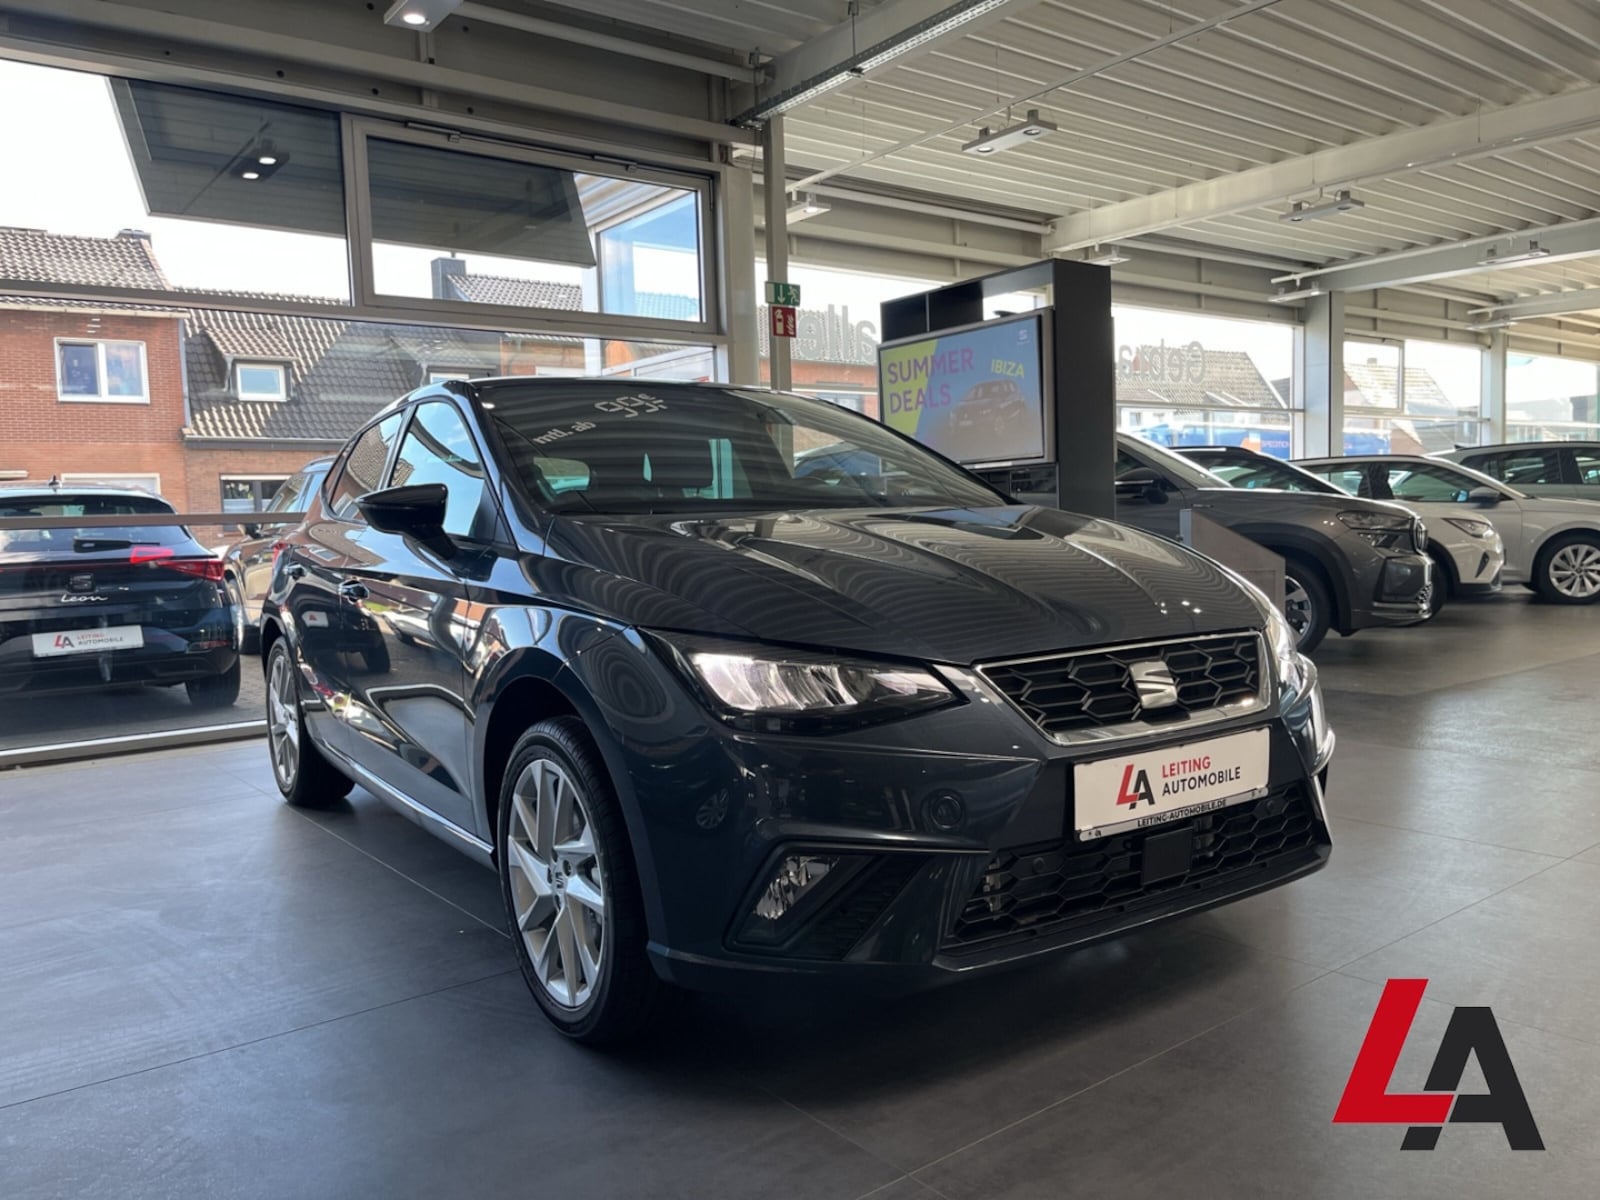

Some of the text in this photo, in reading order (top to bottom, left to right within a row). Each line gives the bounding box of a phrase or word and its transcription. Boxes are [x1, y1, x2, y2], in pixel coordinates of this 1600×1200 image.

[887, 347, 975, 385] SUMMER
[991, 358, 1025, 379] IBIZA
[889, 383, 952, 415] DEALS
[571, 421, 597, 432] ab
[60, 593, 109, 603] Leon
[1161, 755, 1211, 779] LEITING
[1161, 766, 1241, 797] AUTOMOBILE
[1115, 763, 1156, 810] LA
[1137, 799, 1227, 828] LEITING-AUTOMOBILE.DE
